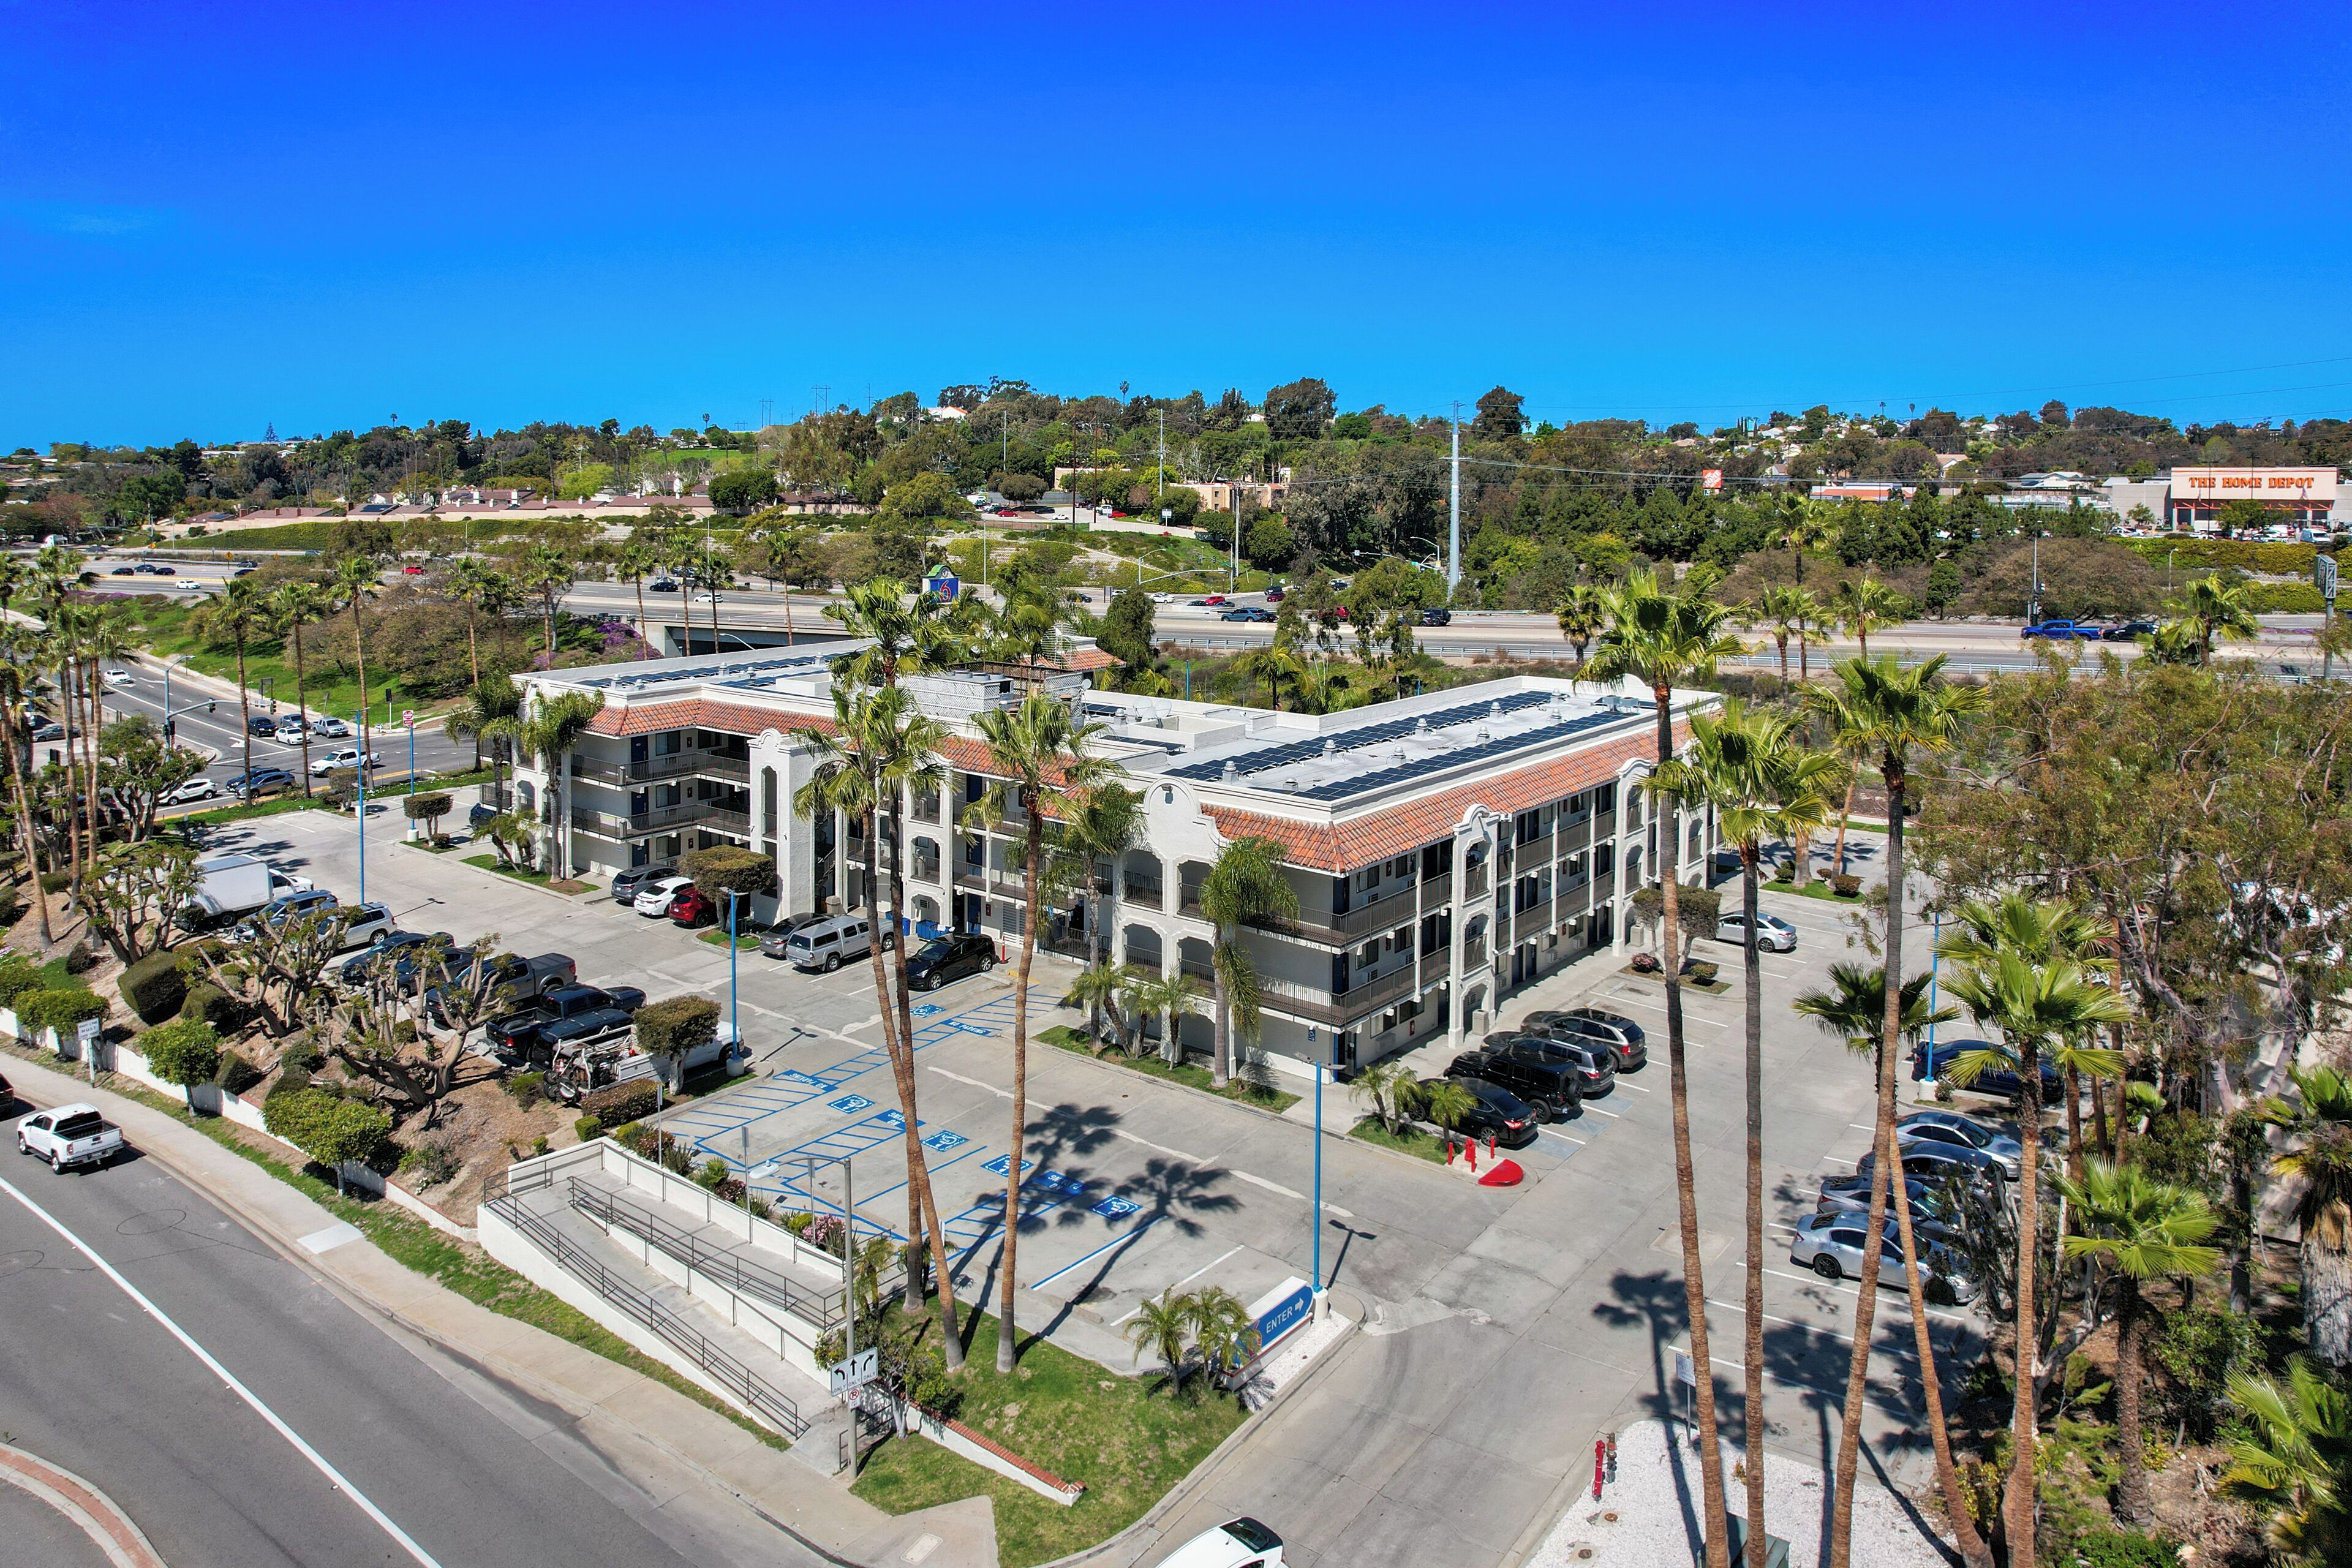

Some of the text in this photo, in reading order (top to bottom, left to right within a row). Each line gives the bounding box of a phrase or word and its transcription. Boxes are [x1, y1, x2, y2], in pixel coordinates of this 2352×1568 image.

[2188, 477, 2315, 488] THE HOME DEPOT
[940, 579, 951, 603] 6
[1305, 941, 1322, 950] 3708
[959, 1023, 987, 1035] PARKING
[790, 1072, 818, 1085] PARKING
[1265, 1306, 1293, 1334] ENTER
[834, 1384, 847, 1392] ONLY
[848, 1378, 861, 1387] ONLY
